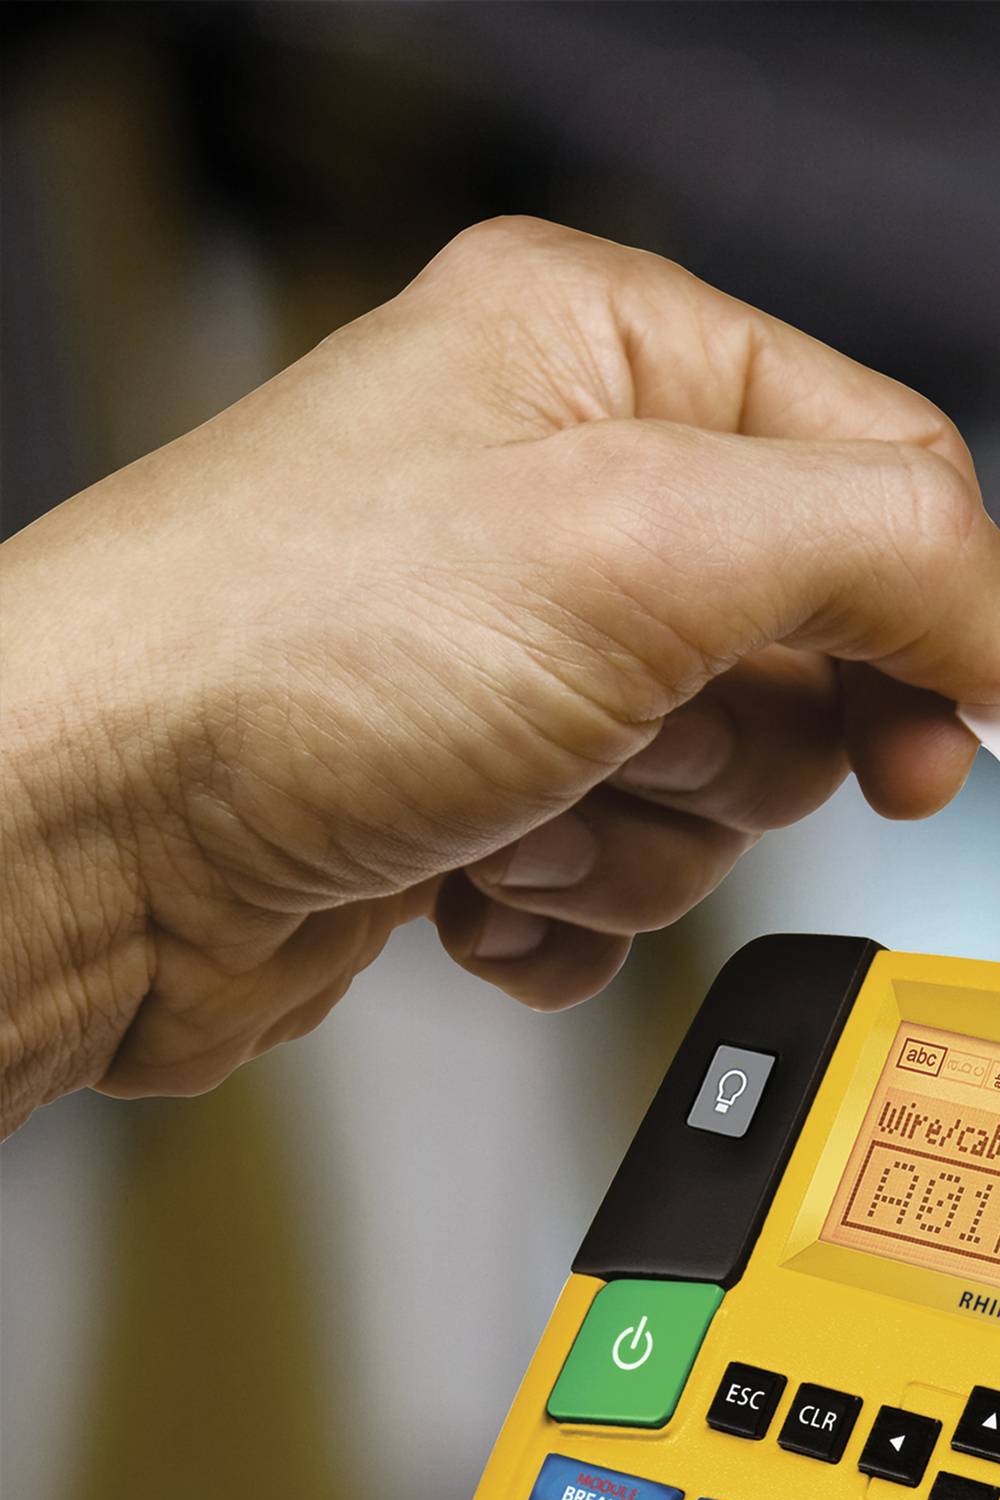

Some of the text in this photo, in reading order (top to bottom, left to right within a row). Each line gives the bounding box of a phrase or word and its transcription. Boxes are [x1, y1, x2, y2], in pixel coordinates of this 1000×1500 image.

[906, 1049, 937, 1067] abc
[725, 1383, 765, 1411] ESC
[798, 1405, 837, 1432] CLR
